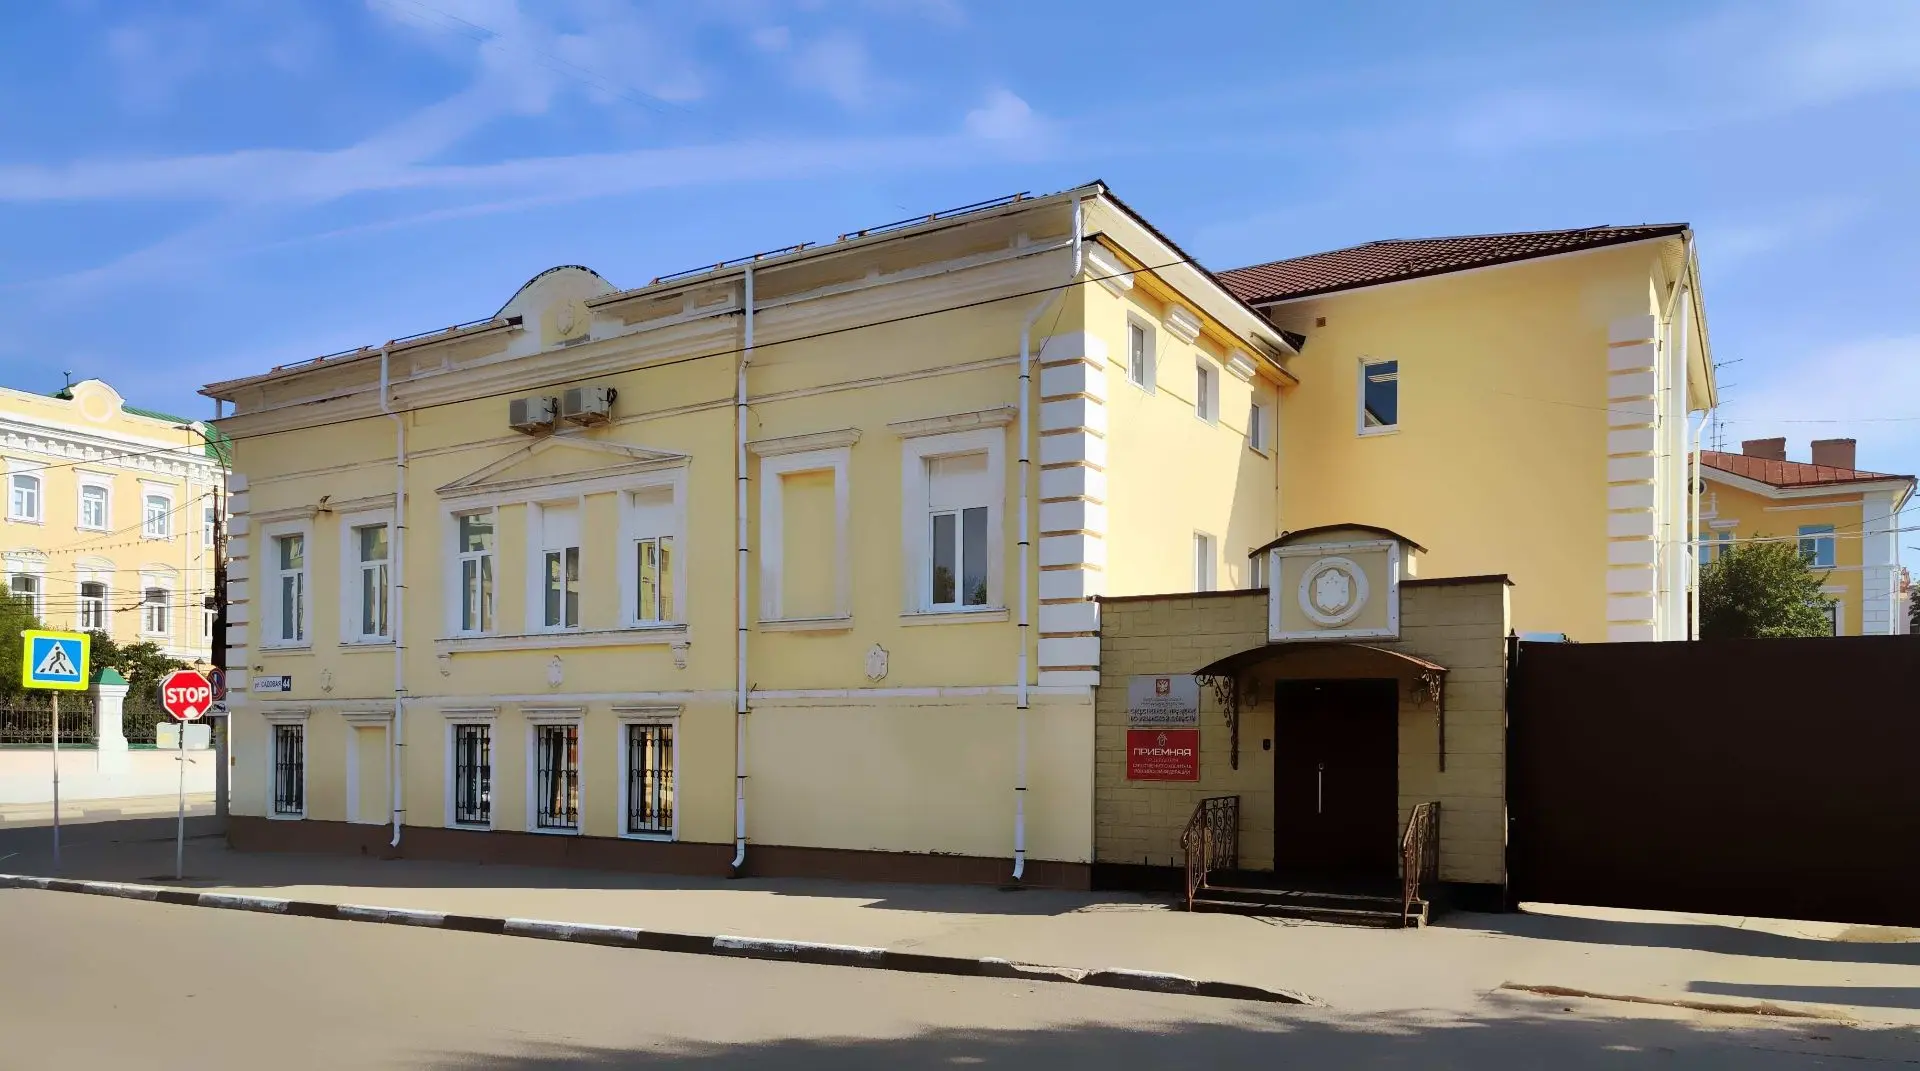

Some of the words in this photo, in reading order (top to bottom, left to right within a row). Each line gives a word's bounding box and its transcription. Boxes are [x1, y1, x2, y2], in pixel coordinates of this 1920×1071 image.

[283, 678, 290, 688] 44
[167, 687, 209, 704] STOP
[1133, 748, 1192, 757] ПРИЕМНАЯ
